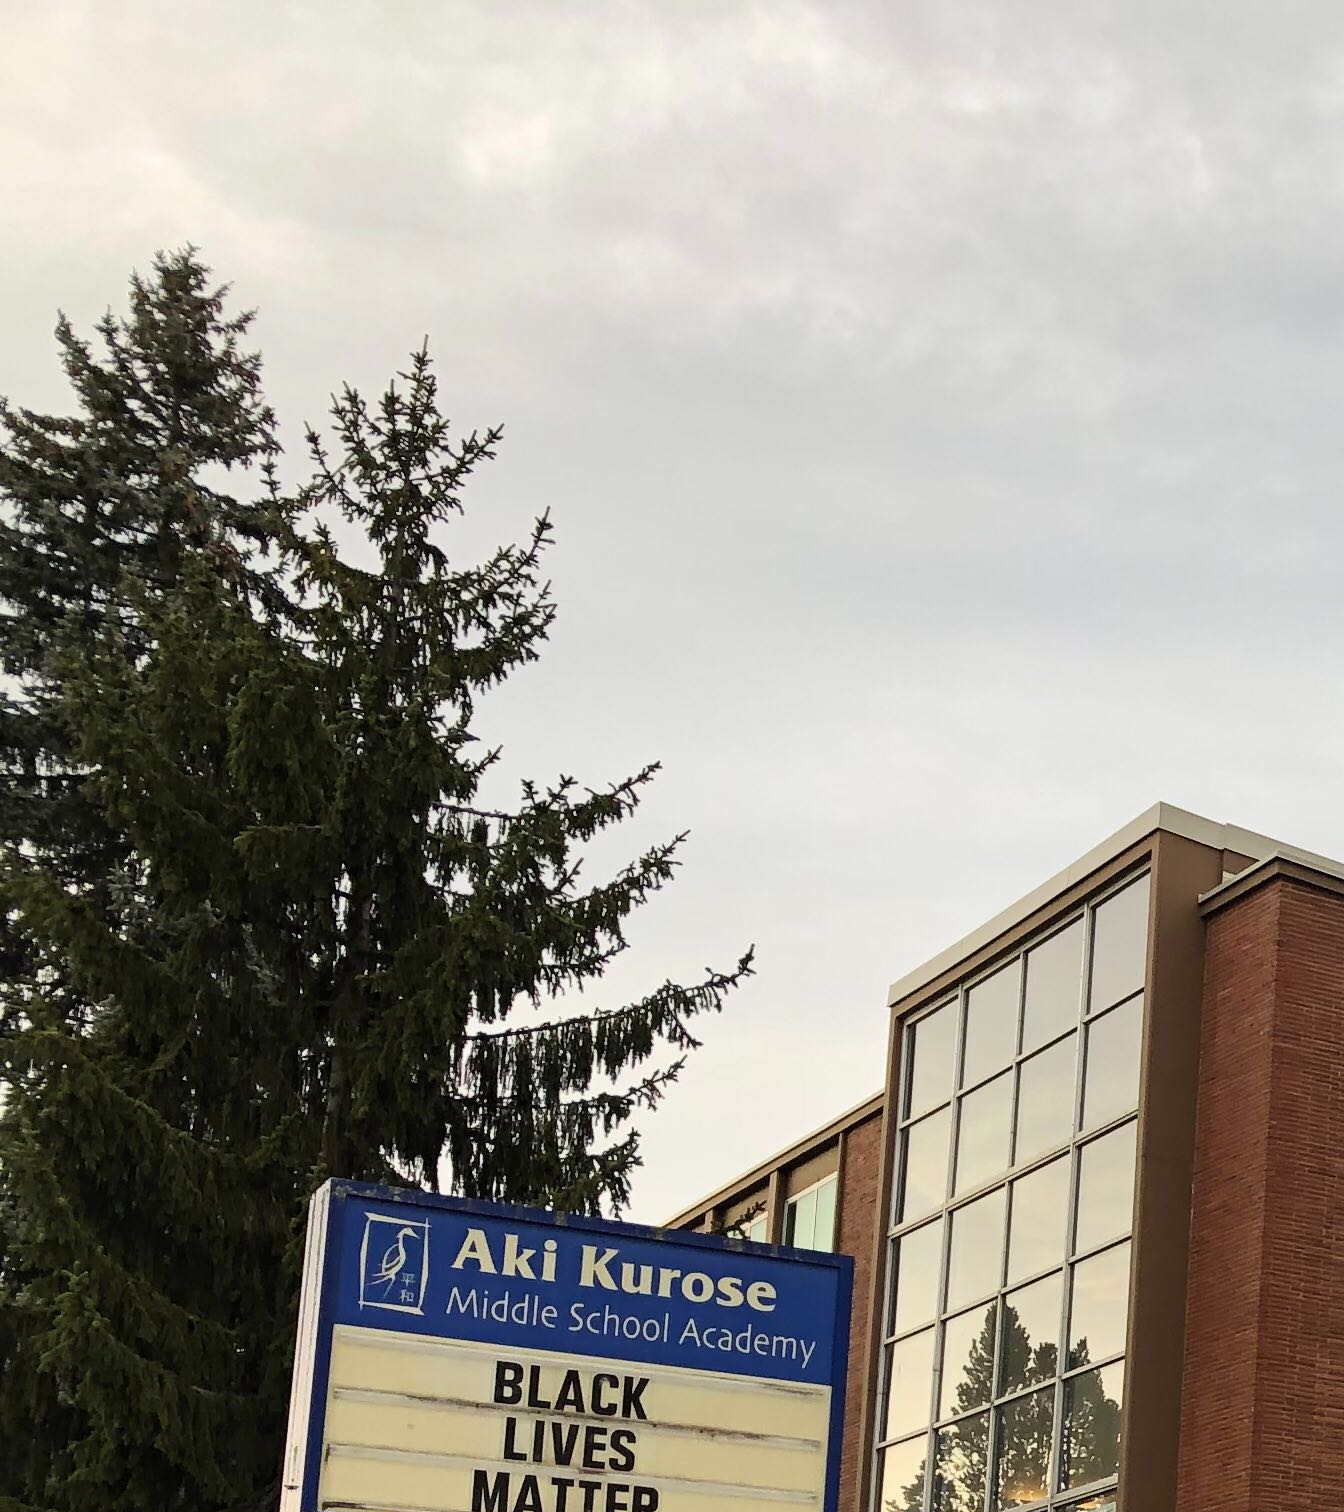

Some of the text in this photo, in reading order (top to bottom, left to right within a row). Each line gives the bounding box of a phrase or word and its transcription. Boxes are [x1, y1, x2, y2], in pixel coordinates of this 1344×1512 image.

[400, 1272, 416, 1303] 平和
[450, 1227, 778, 1313] Aki Kurose
[445, 1286, 817, 1369] Middle School Academy
[493, 1360, 651, 1421] BLACK
[503, 1416, 637, 1474] LIVES
